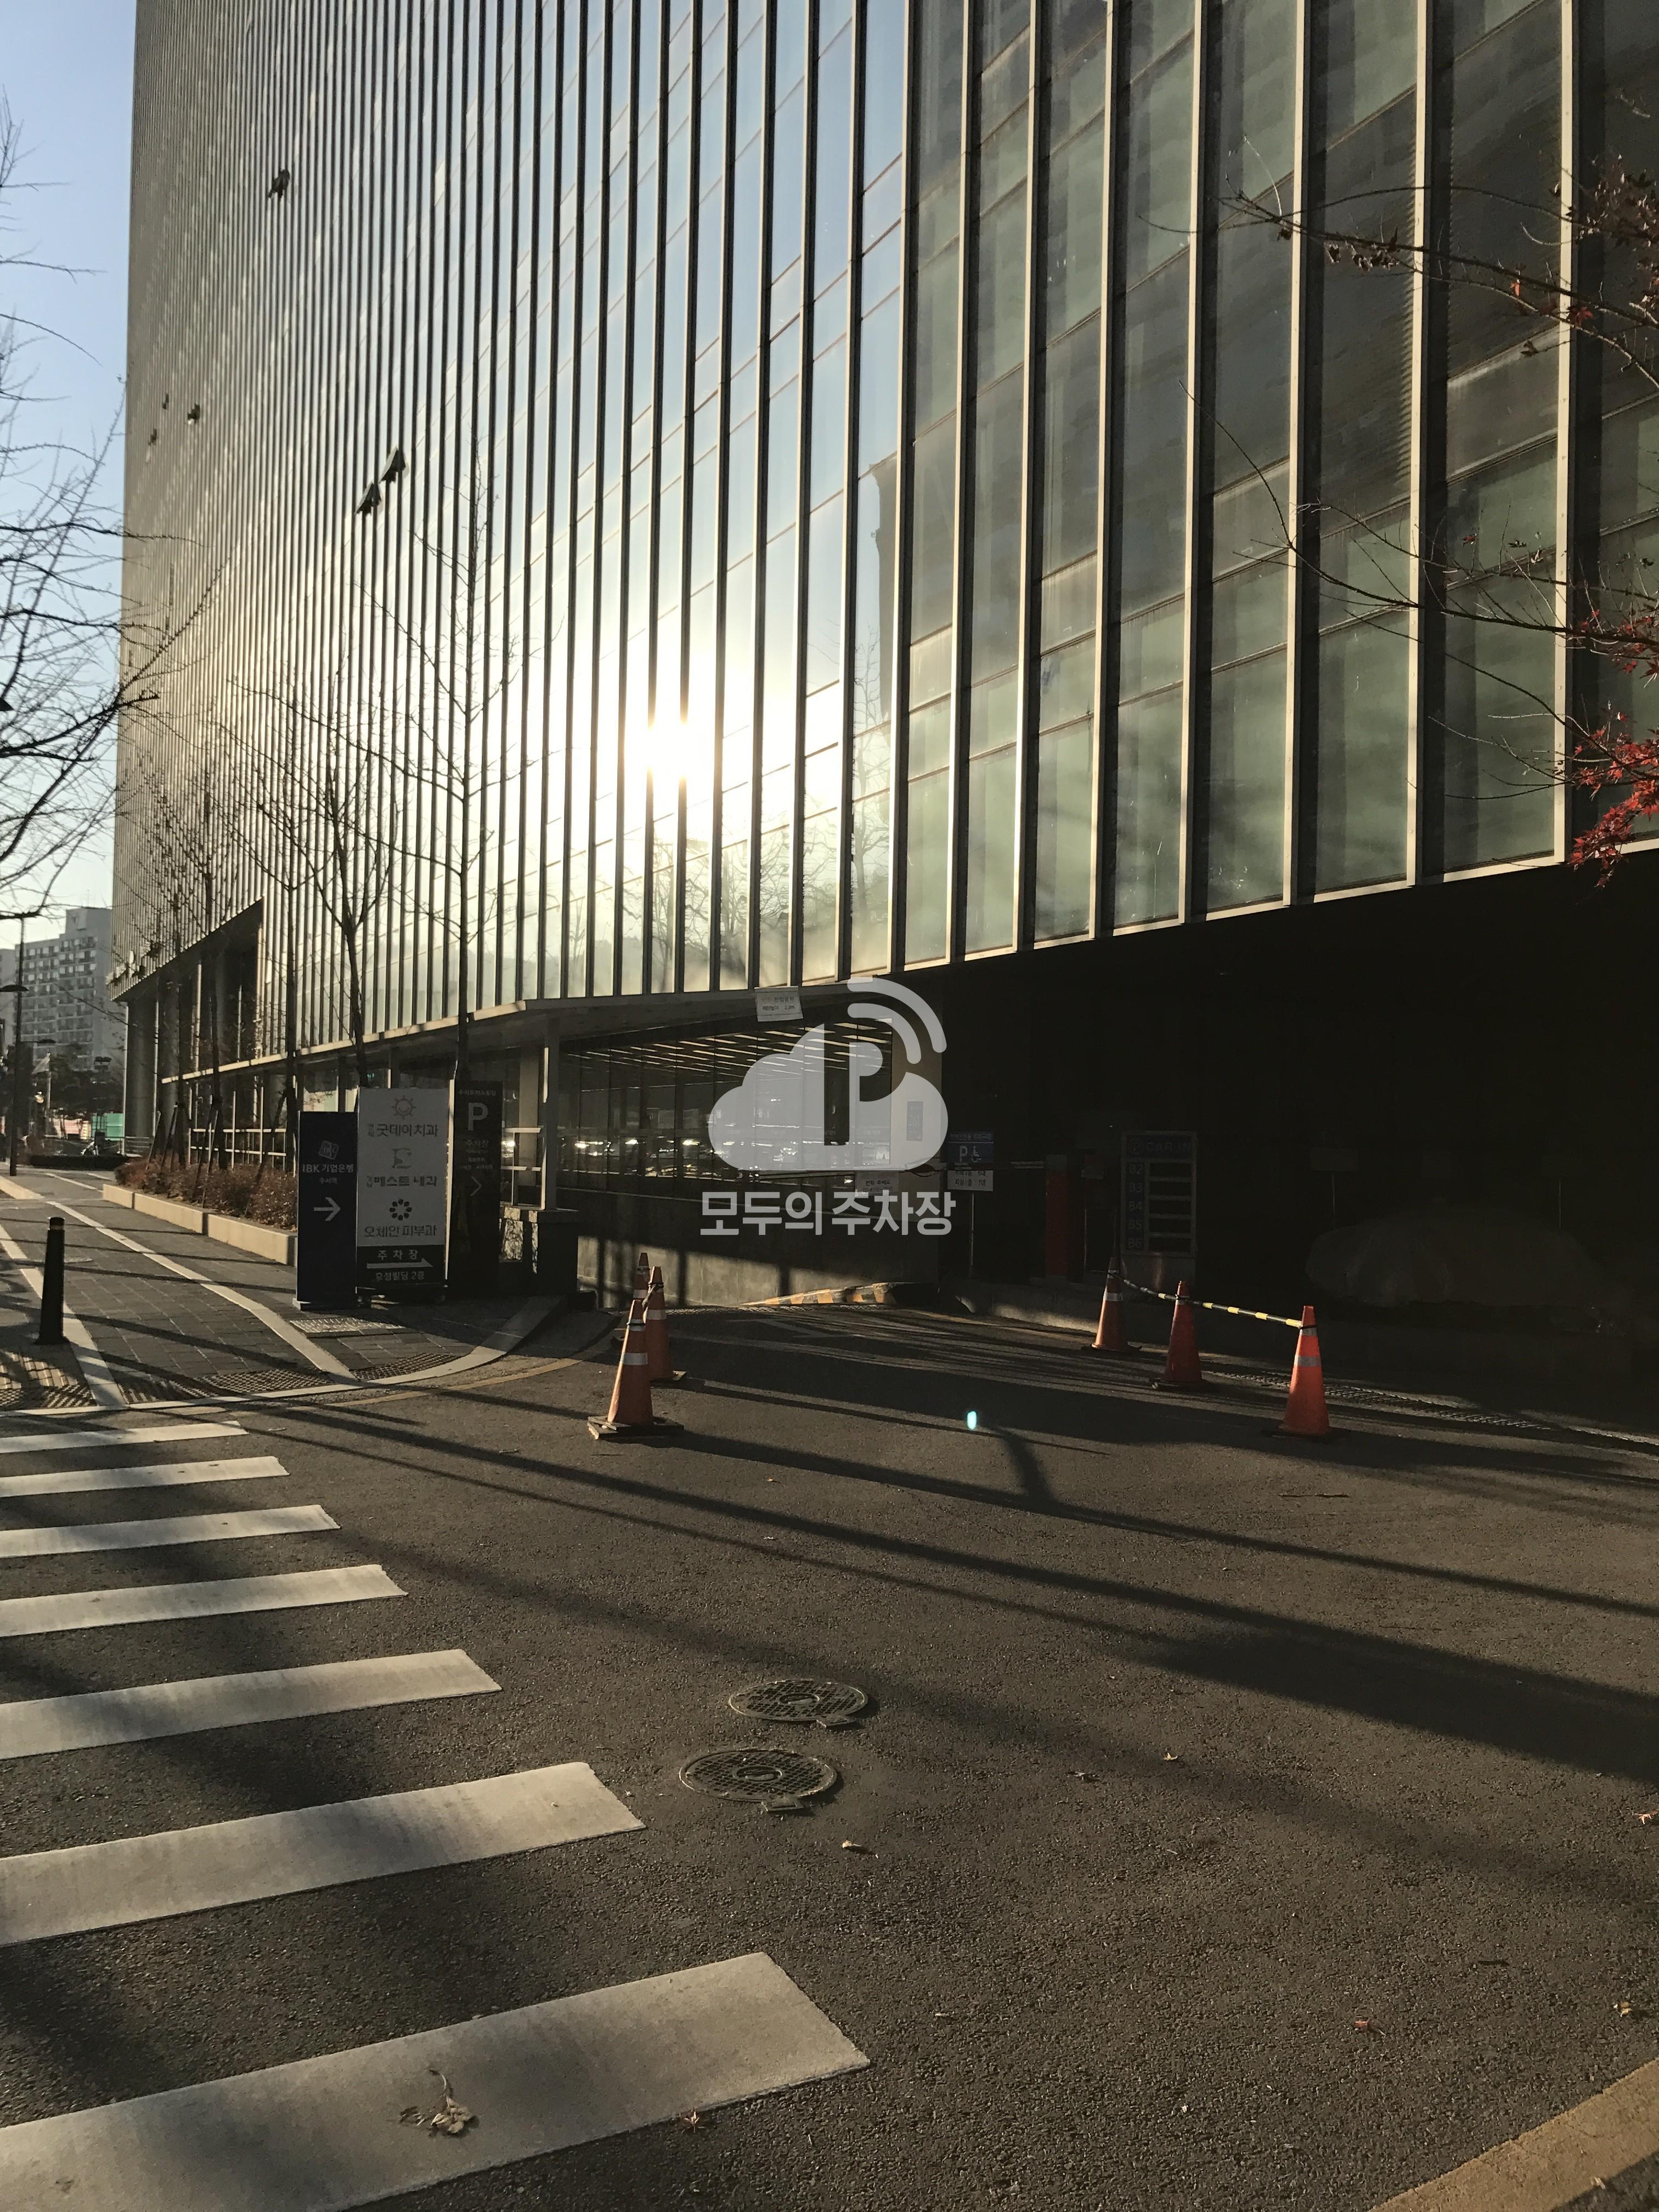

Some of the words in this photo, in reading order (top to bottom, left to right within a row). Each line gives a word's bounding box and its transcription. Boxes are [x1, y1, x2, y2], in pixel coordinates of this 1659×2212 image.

[468, 1102, 488, 1131] P
[377, 1124, 439, 1137] 굿데이치과
[959, 1145, 968, 1163] P
[302, 1163, 320, 1173] IBK
[321, 1163, 354, 1173] 기업은행
[374, 1176, 410, 1187] 베스트
[414, 1176, 437, 1187] 내과
